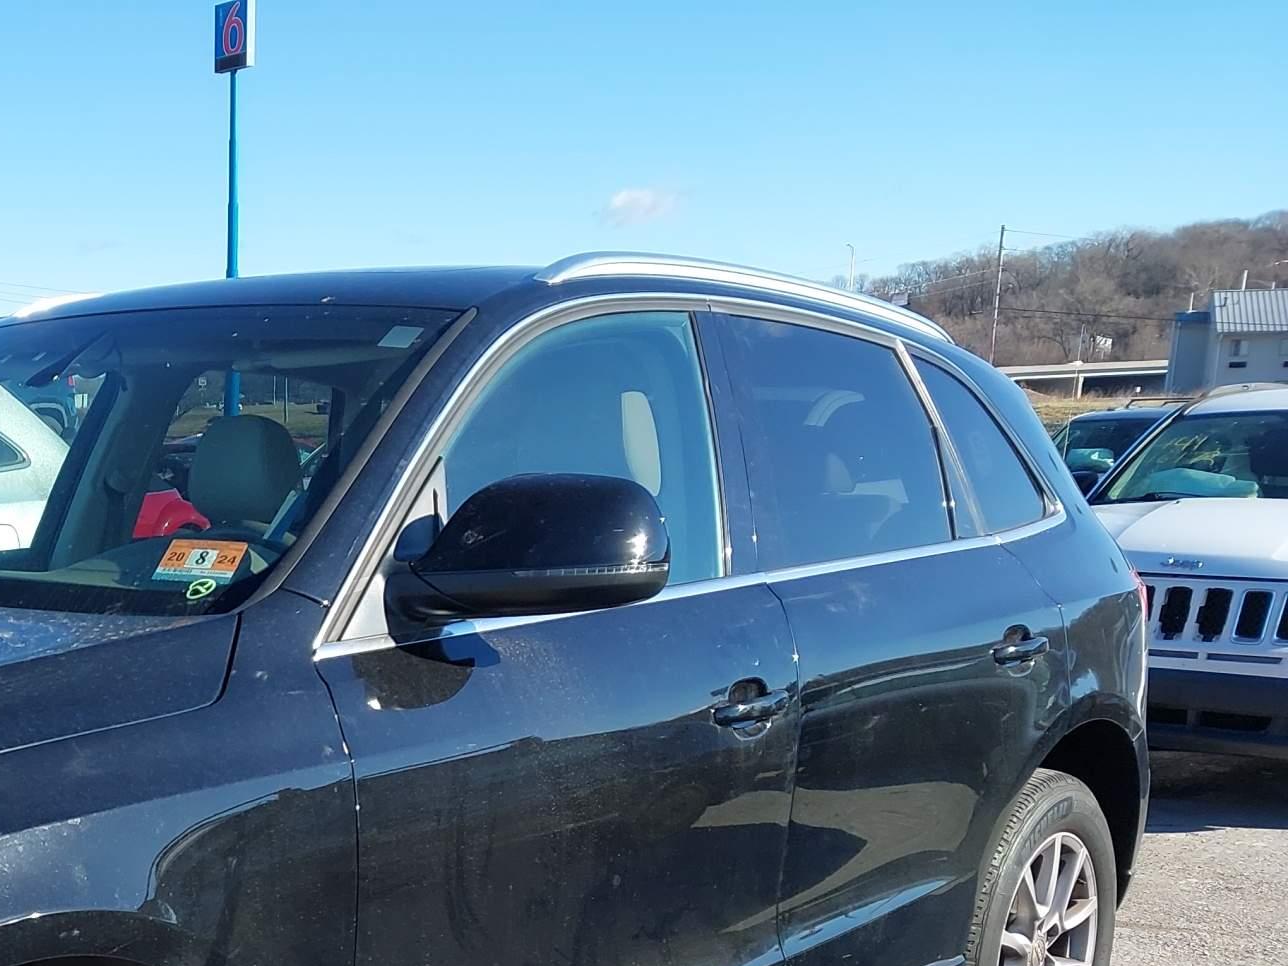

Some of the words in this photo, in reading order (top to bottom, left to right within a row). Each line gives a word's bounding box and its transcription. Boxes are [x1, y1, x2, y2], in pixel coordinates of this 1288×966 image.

[223, 1, 244, 56] 6
[168, 552, 185, 562] 20
[195, 551, 209, 565] 8
[218, 555, 237, 565] 24
